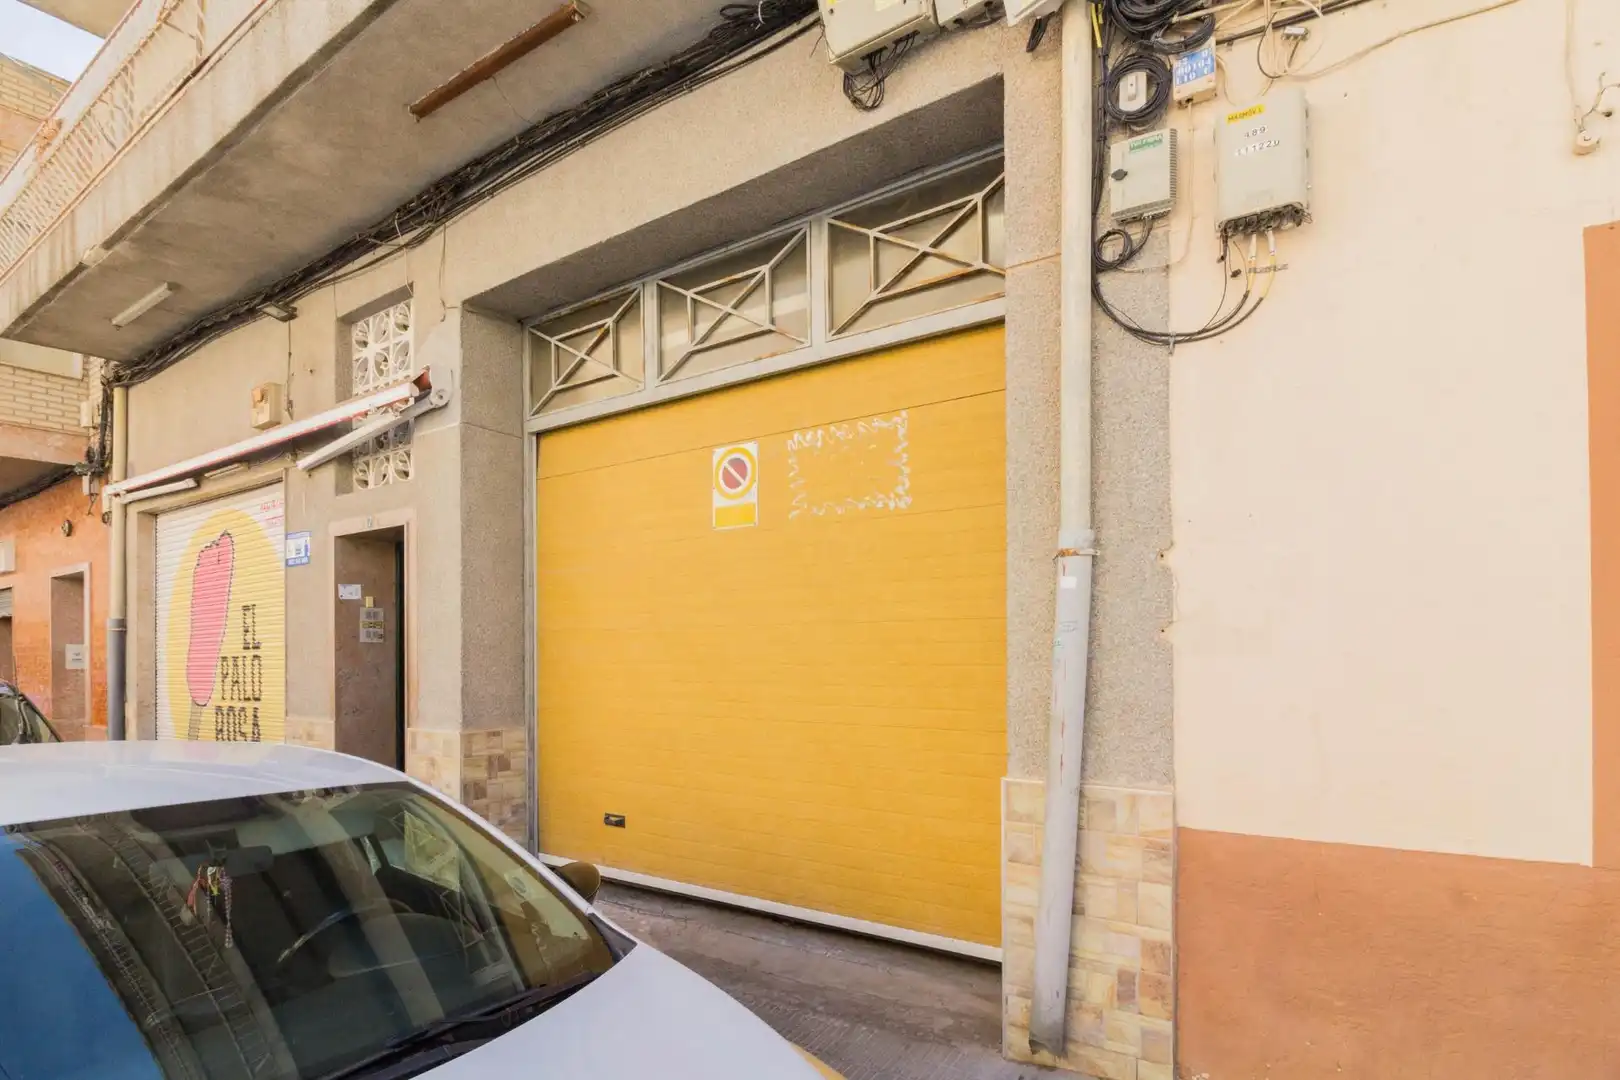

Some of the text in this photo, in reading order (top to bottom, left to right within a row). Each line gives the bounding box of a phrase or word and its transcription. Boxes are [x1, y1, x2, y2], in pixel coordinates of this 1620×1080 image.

[241, 604, 261, 650] EL
[220, 654, 262, 701] PALO
[214, 706, 261, 742] ROSA
